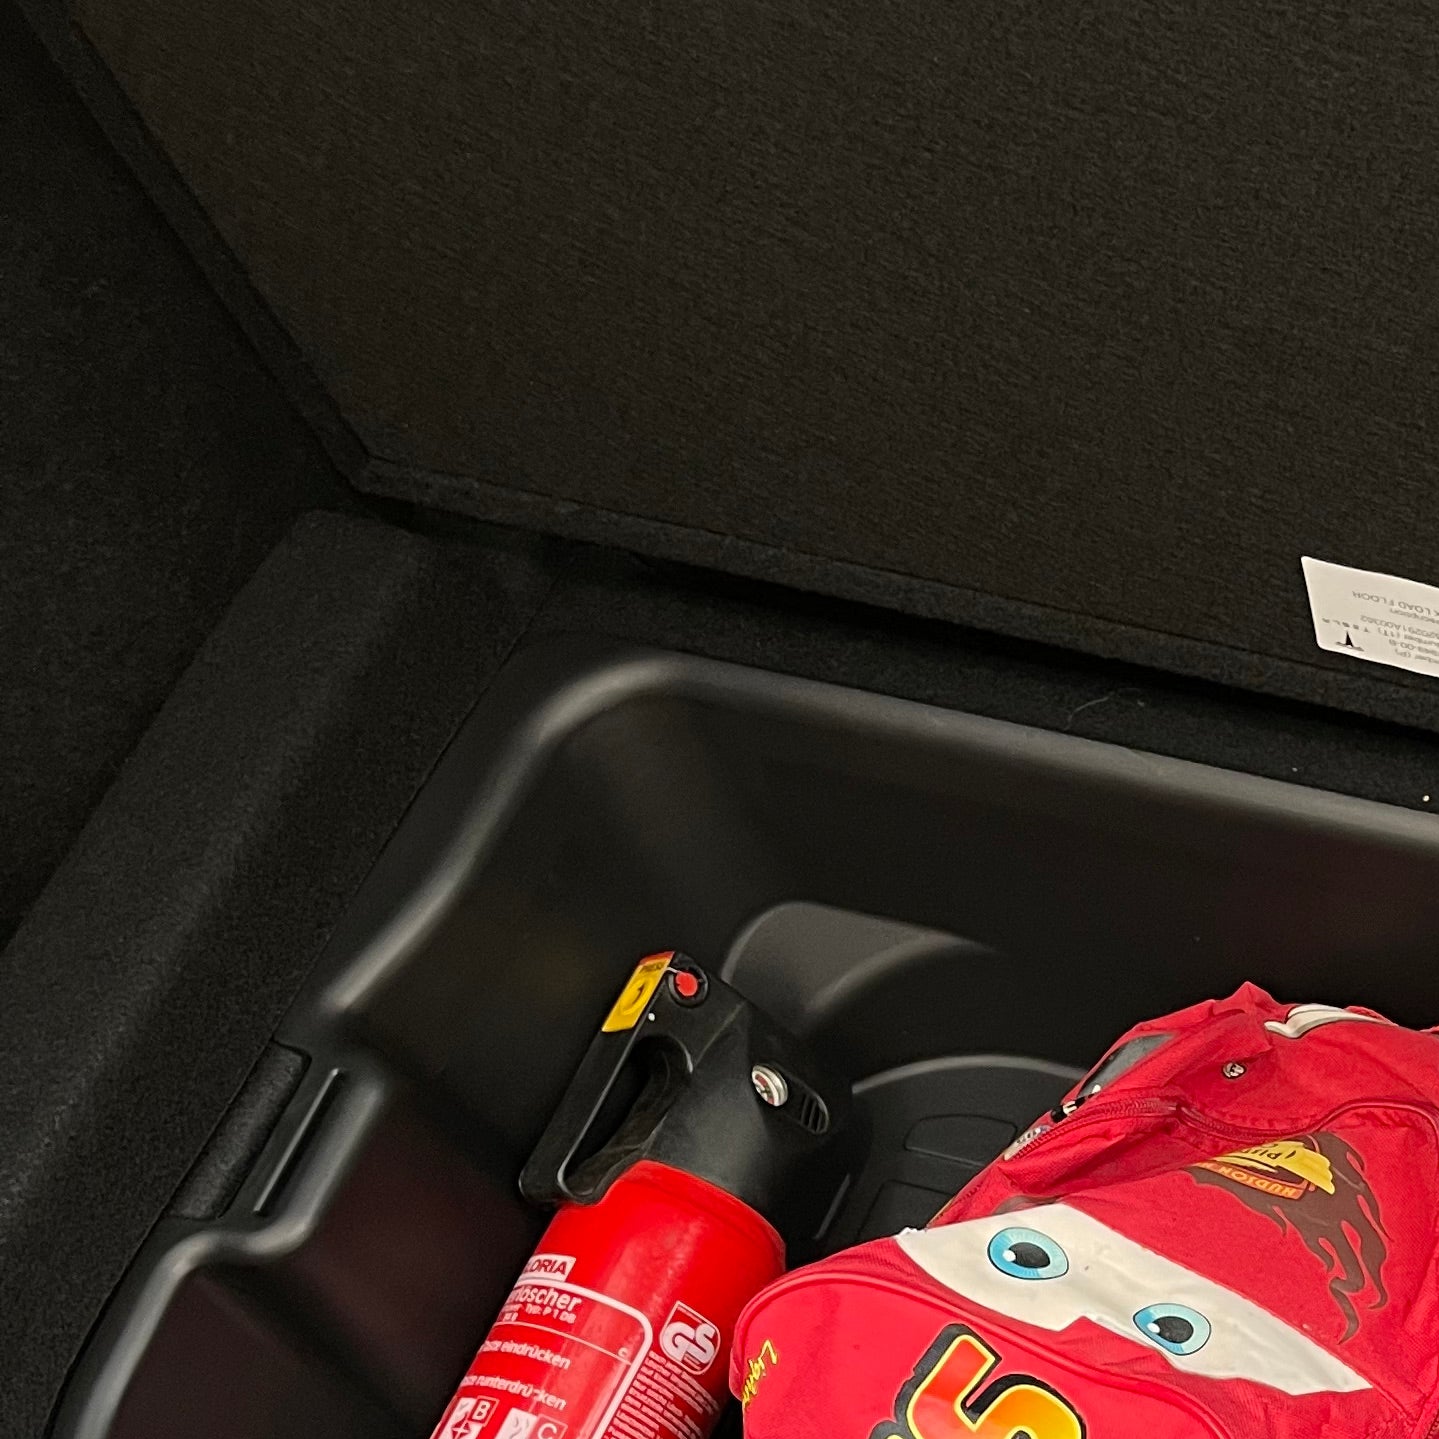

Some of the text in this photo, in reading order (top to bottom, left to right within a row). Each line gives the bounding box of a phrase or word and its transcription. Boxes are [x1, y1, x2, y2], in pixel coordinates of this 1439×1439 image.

[1351, 591, 1395, 606] FLOOR
[1397, 601, 1432, 616] LOAD
[1321, 618, 1370, 633] TESLA
[663, 1321, 716, 1364] GS
[472, 1400, 491, 1421] B
